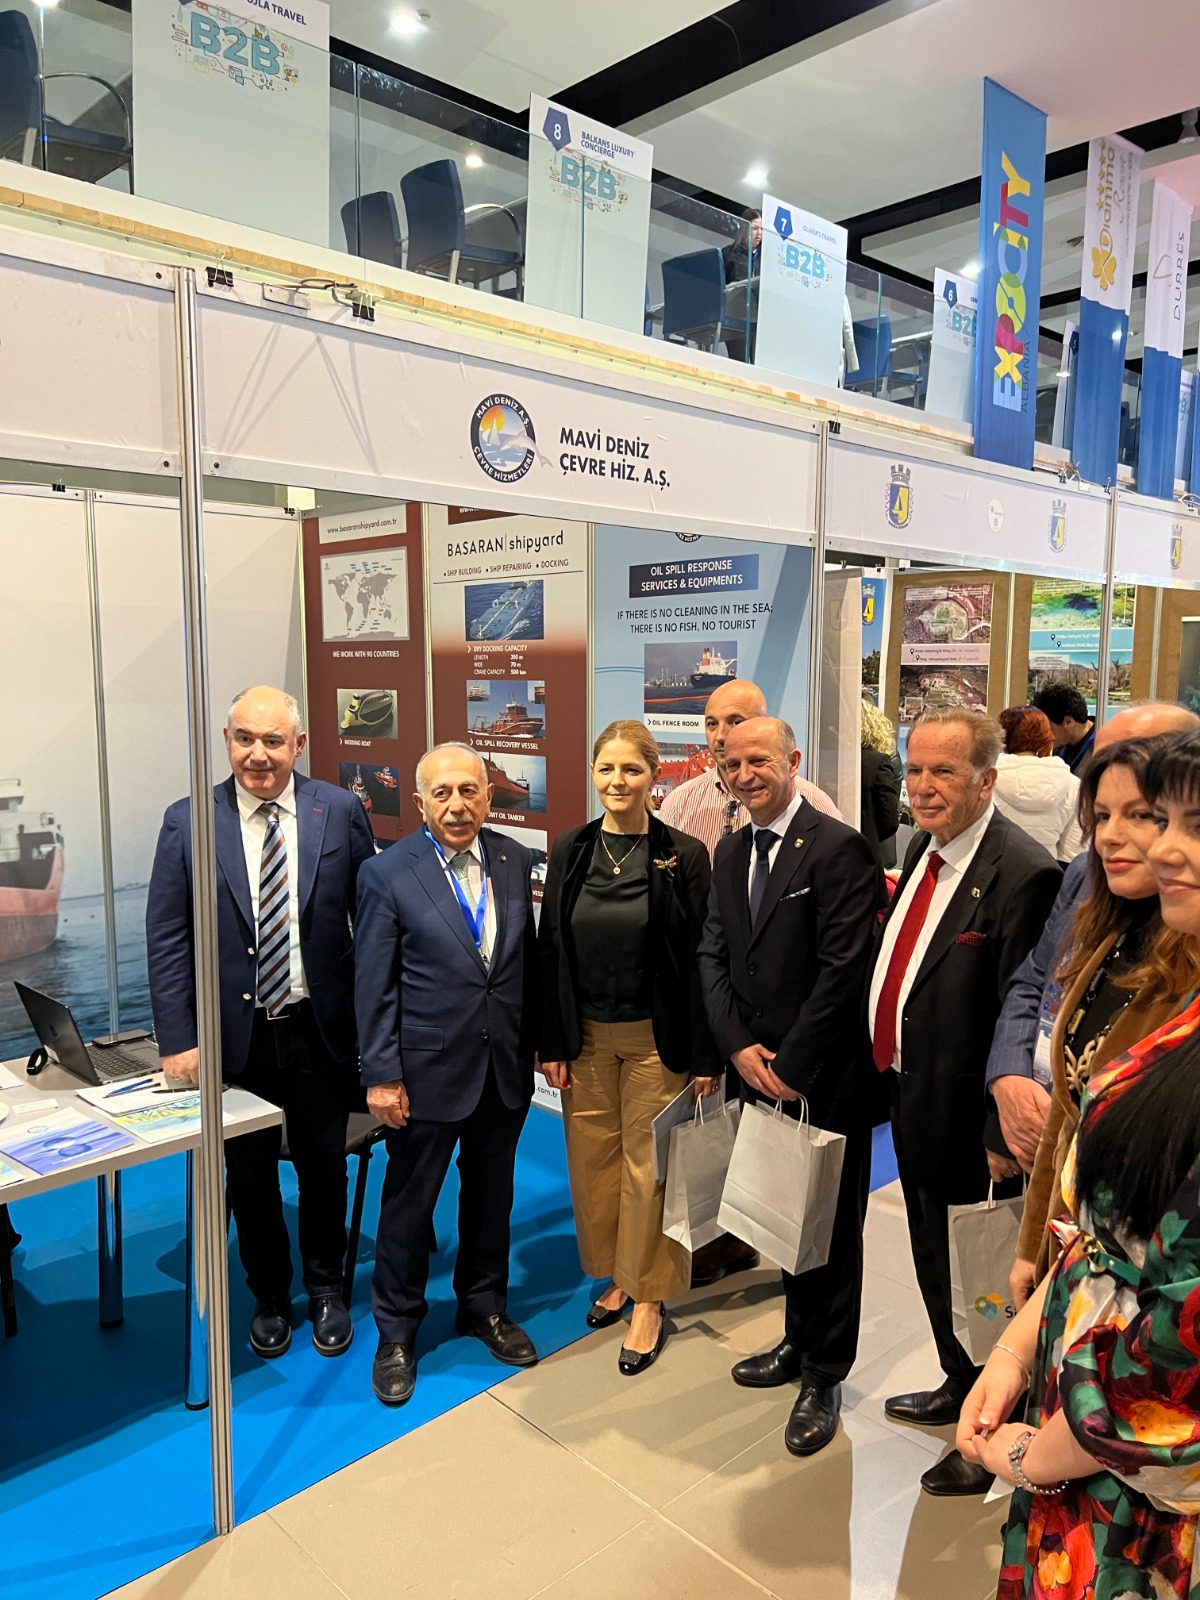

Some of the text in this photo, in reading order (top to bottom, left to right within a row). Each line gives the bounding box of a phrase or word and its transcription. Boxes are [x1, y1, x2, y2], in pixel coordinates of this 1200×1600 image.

[271, 3, 307, 26] TRAVEL
[190, 11, 280, 76] B2B
[553, 123, 562, 140] 8
[580, 139, 615, 159] CONCIERGE
[581, 131, 635, 158] BALKANS LUXURY
[560, 155, 617, 201] B2B
[780, 217, 788, 232] 7
[821, 233, 837, 245] TRAVEL
[785, 244, 825, 279] B2B
[1173, 231, 1185, 321] DURRËS
[948, 289, 954, 302] 6
[1021, 340, 1031, 415] ALBANIA
[494, 396, 517, 411] DENİZ
[559, 427, 650, 460] MAVİ DENİZ
[473, 446, 494, 475] ÇEVRE
[559, 452, 671, 491] ÇEVRE HİZ. A.Ş.
[447, 529, 564, 557] BASARAN shipyard
[447, 558, 569, 577] SHIP BUILDING SHIP REPAIRING DOCKING
[650, 559, 733, 576] OIL SPILL RESPONSE
[641, 574, 743, 592] SERVICES & EQUIPMENTS
[617, 611, 623, 620] IF
[625, 609, 649, 620] THERE
[650, 609, 658, 619] IS
[659, 608, 672, 618] NO
[674, 605, 718, 617] CLEANING
[720, 605, 731, 615] IN
[732, 603, 750, 615] THE
[630, 619, 756, 634] THERE IS NO FISH, NO TOURIST
[332, 650, 341, 658] WE
[340, 650, 354, 658] WORK
[373, 650, 400, 658] COUNTRIES
[504, 644, 528, 652] CAPACITY
[662, 719, 681, 727] FENCE
[484, 739, 496, 747] SPILL
[496, 740, 521, 749] RECOVERY
[520, 742, 539, 750] VESSEL
[498, 812, 507, 820] OIL
[507, 813, 526, 822] TANKER
